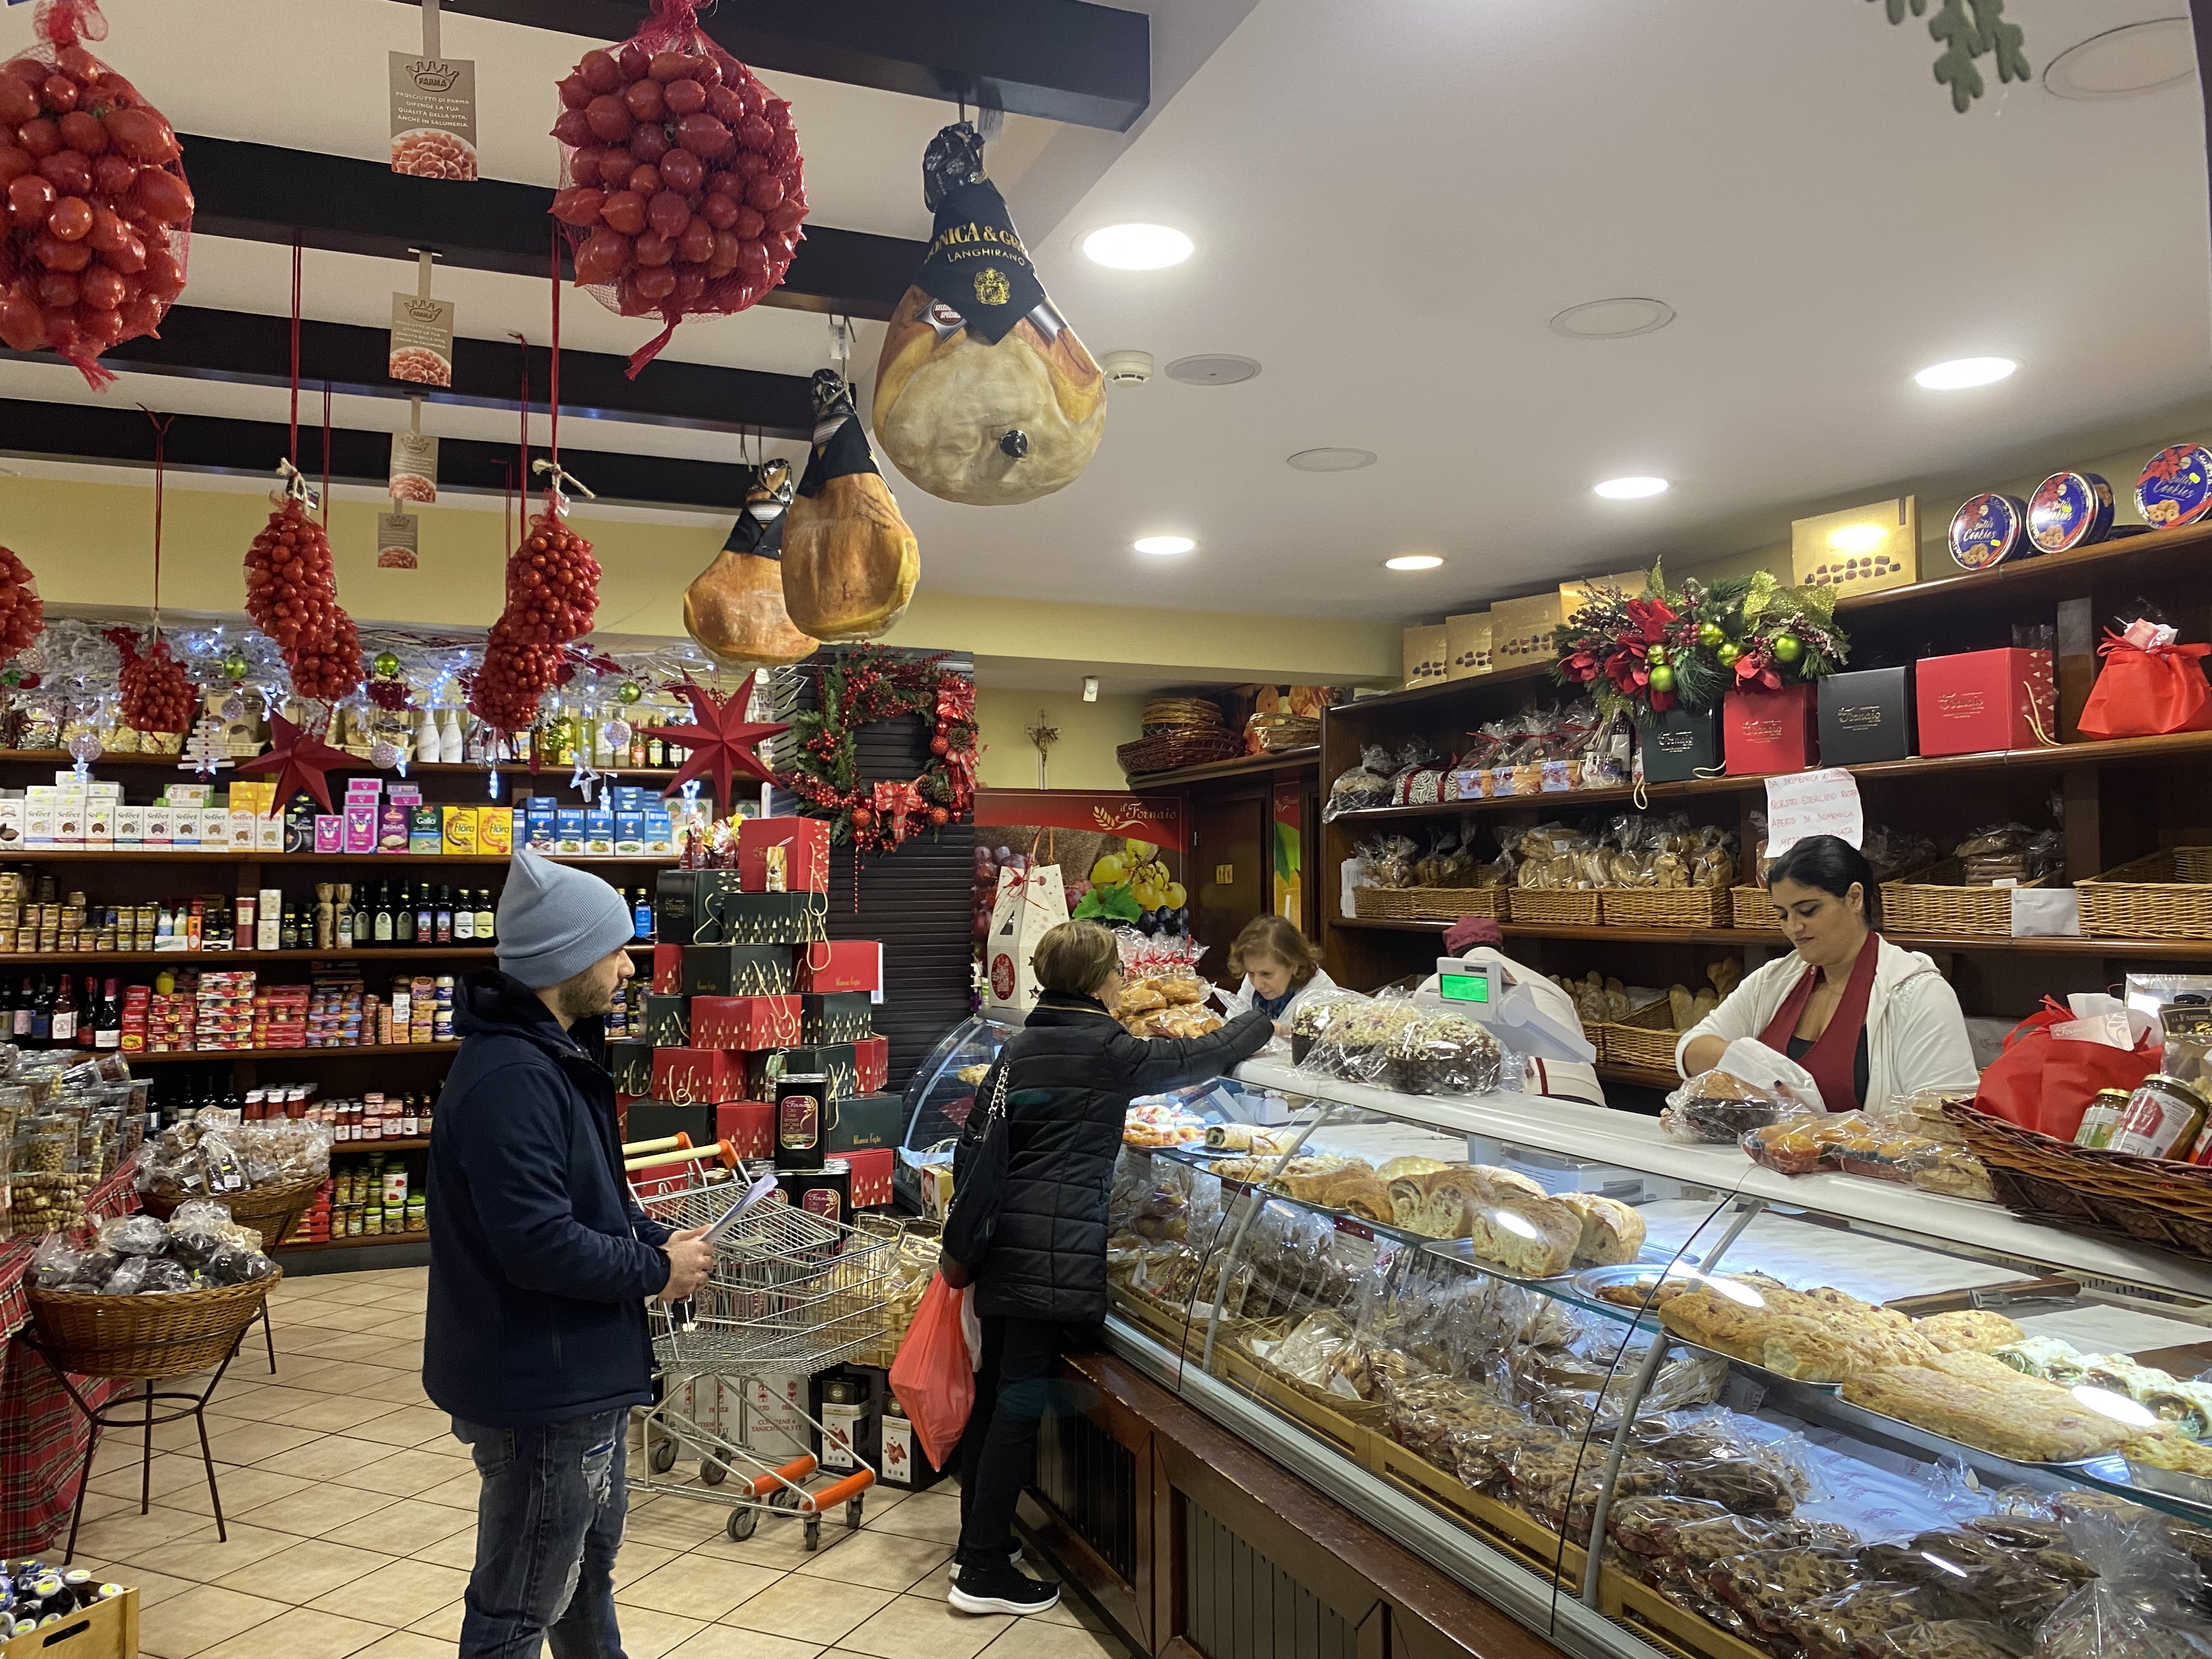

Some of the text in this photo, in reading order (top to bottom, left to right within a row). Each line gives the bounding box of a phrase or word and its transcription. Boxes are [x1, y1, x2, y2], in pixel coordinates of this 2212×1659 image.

[419, 77, 447, 87] PARMA
[396, 91, 437, 101] PROSCIUTTO
[407, 101, 433, 109] DIFENDE
[983, 225, 998, 242] &
[947, 248, 1025, 266] LANGHIRANO
[2153, 481, 2195, 498] Cookies
[1963, 528, 1997, 541] Cookies
[1839, 707, 1881, 723] Fornaio
[1768, 780, 1779, 789] DA
[1784, 775, 1818, 786] DOMENICA
[1770, 798, 1797, 810] QUESTO
[1802, 793, 1836, 805] ESERCIZIO
[1120, 802, 1176, 819] il Fornaio
[1771, 818, 1796, 828] APERTO
[1816, 811, 1853, 822] DOMENICA
